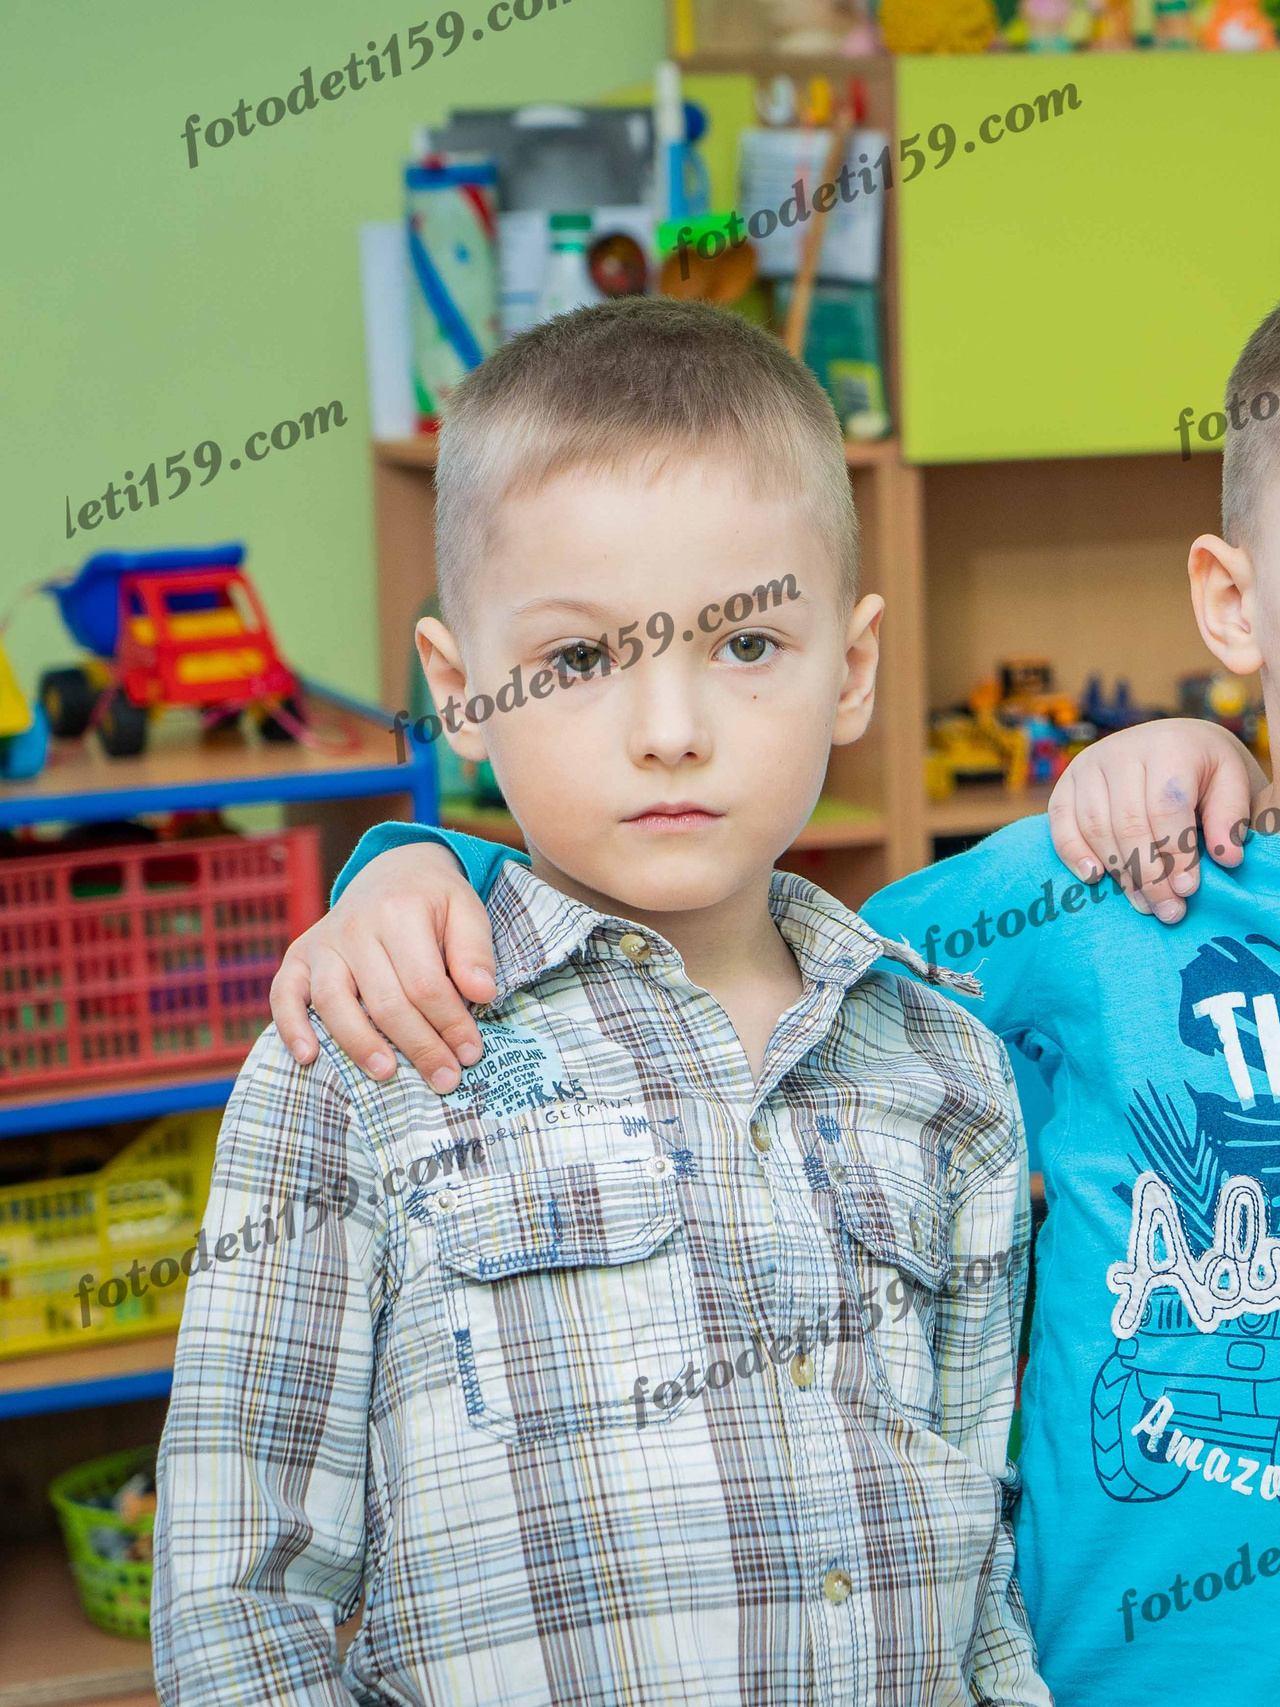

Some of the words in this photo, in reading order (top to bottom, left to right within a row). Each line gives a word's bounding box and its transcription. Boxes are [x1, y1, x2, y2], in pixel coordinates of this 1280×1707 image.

[467, 1059, 498, 1086] CLUB
[498, 1048, 547, 1070] AIRPLANE
[497, 1062, 541, 1082] CONCERT
[513, 1070, 536, 1083] GYM
[516, 1076, 544, 1088] CAMPUS
[502, 1090, 525, 1106] APR.
[546, 1095, 633, 1123] GERMANY
